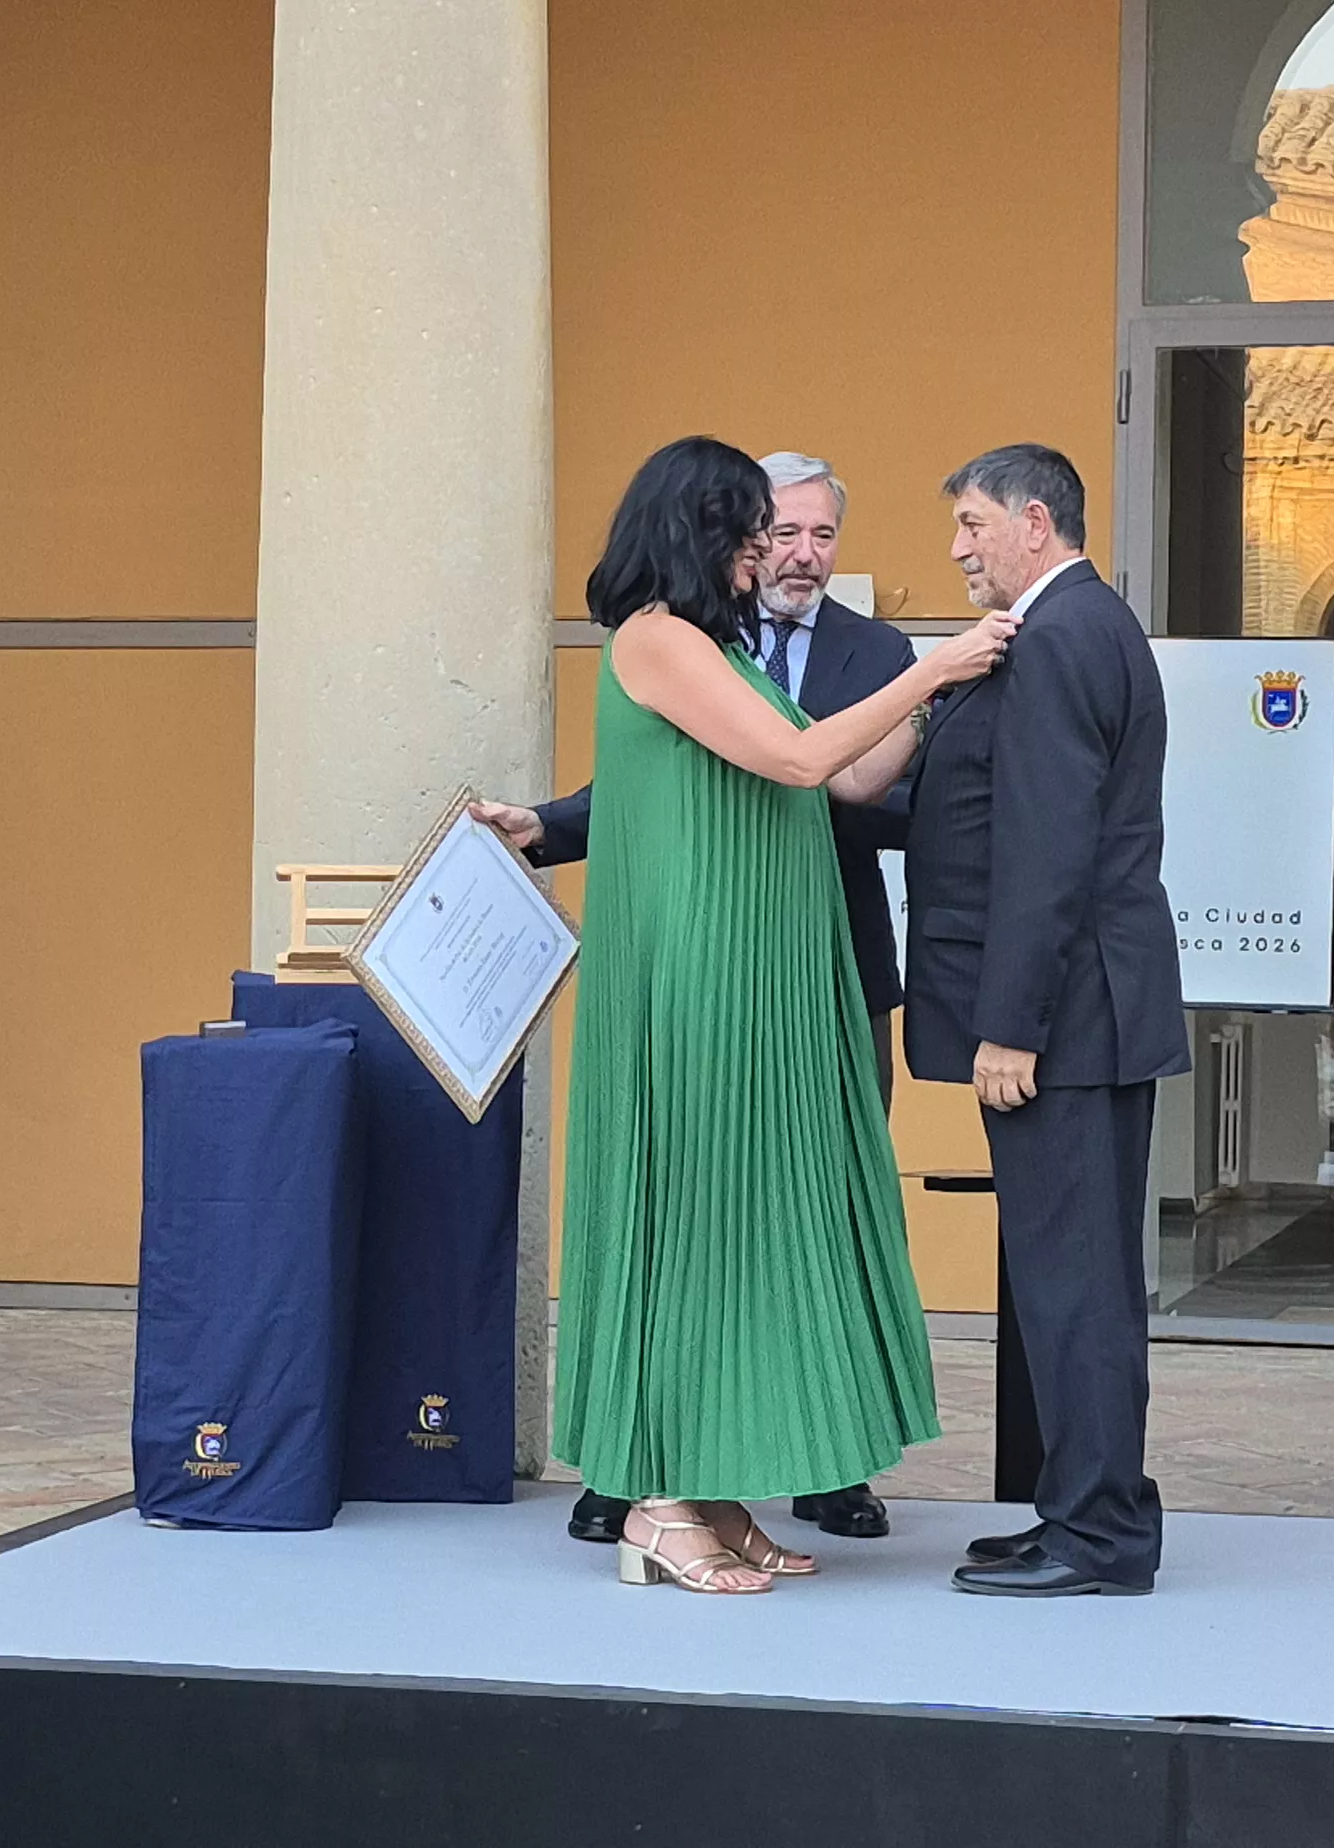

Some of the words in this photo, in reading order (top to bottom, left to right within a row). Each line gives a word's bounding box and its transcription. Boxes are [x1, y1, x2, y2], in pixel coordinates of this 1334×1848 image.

[1177, 911, 1189, 923] a
[1205, 908, 1302, 924] Ciudad
[1179, 938, 1223, 951] sca
[1238, 937, 1302, 953] 2026
